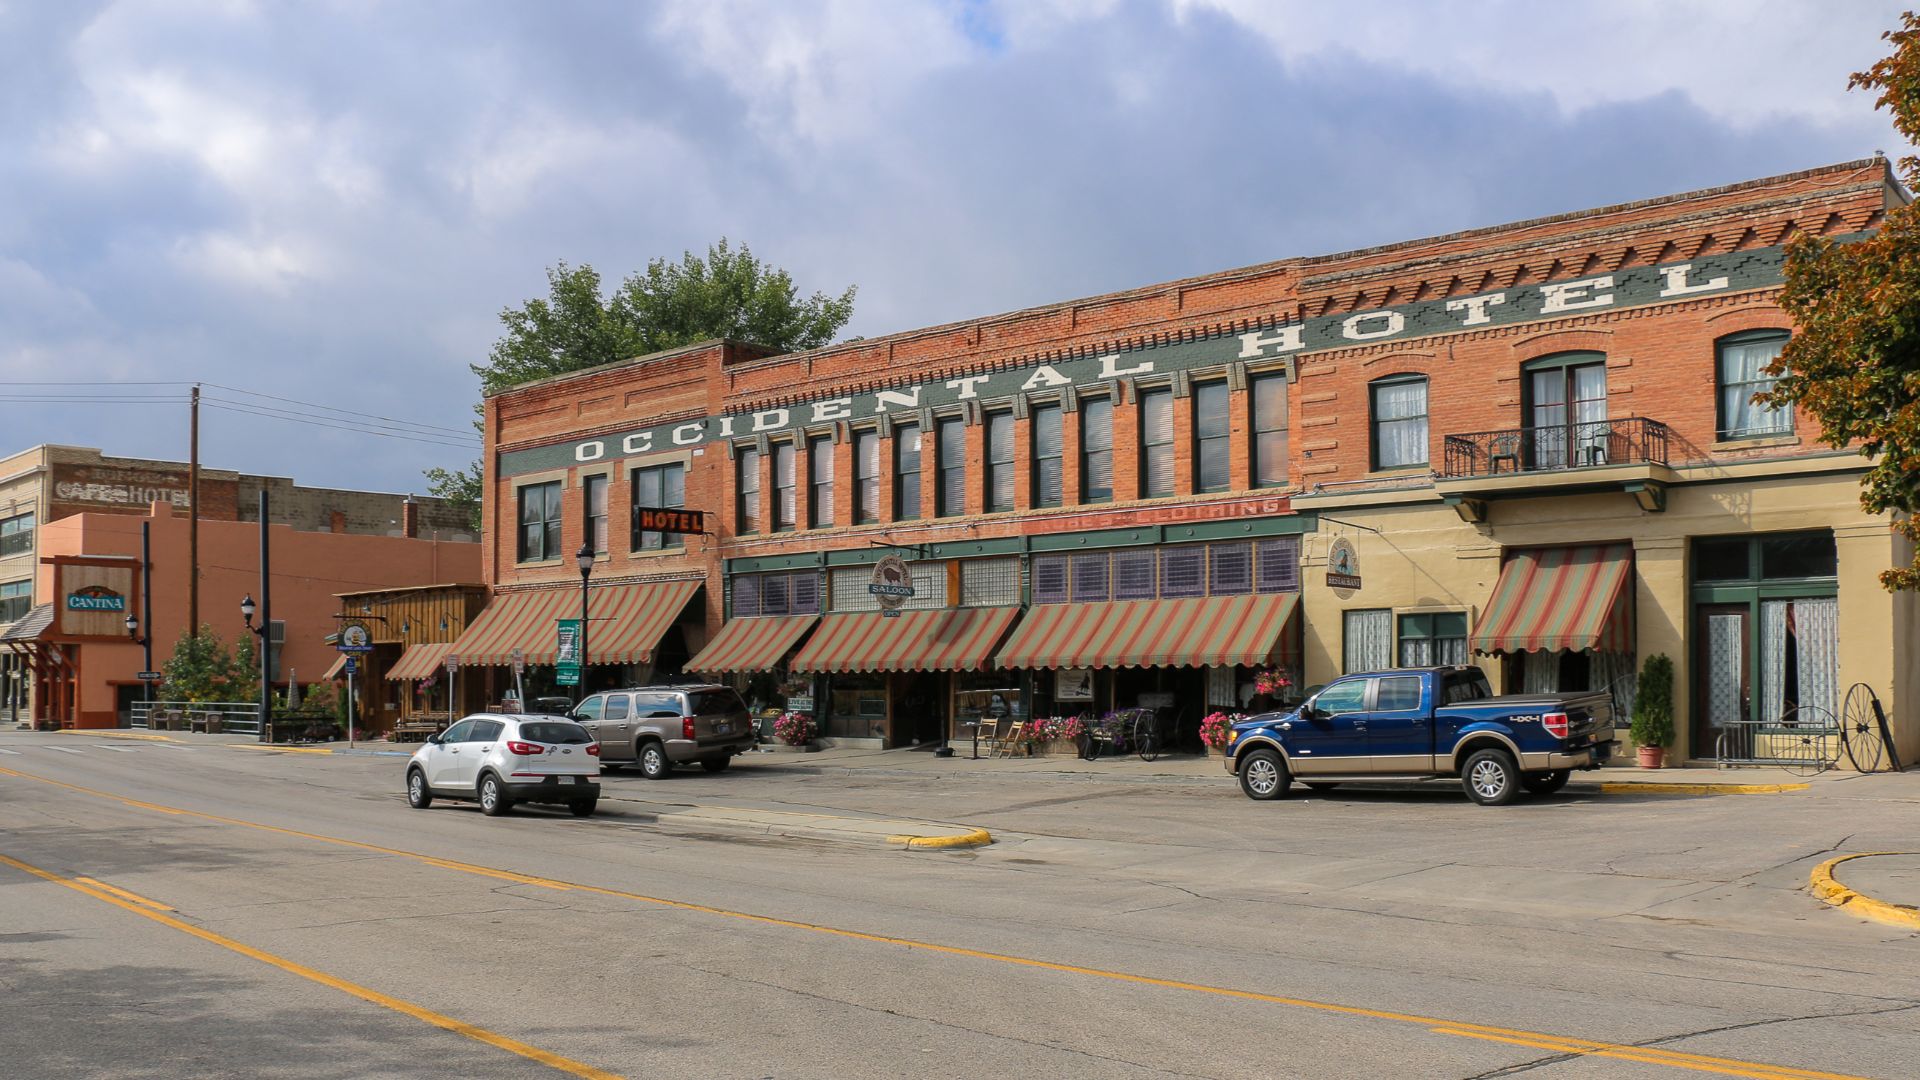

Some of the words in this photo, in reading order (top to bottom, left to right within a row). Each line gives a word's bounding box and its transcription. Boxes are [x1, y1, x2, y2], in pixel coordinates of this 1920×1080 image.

[575, 354, 1154, 462] OCCIDENTAL
[1237, 263, 1729, 357] HOTEL
[642, 511, 702, 530] HOTEL
[1328, 575, 1360, 587] RESTAURANT
[872, 585, 911, 595] SALOON
[69, 596, 123, 609] CANTINA
